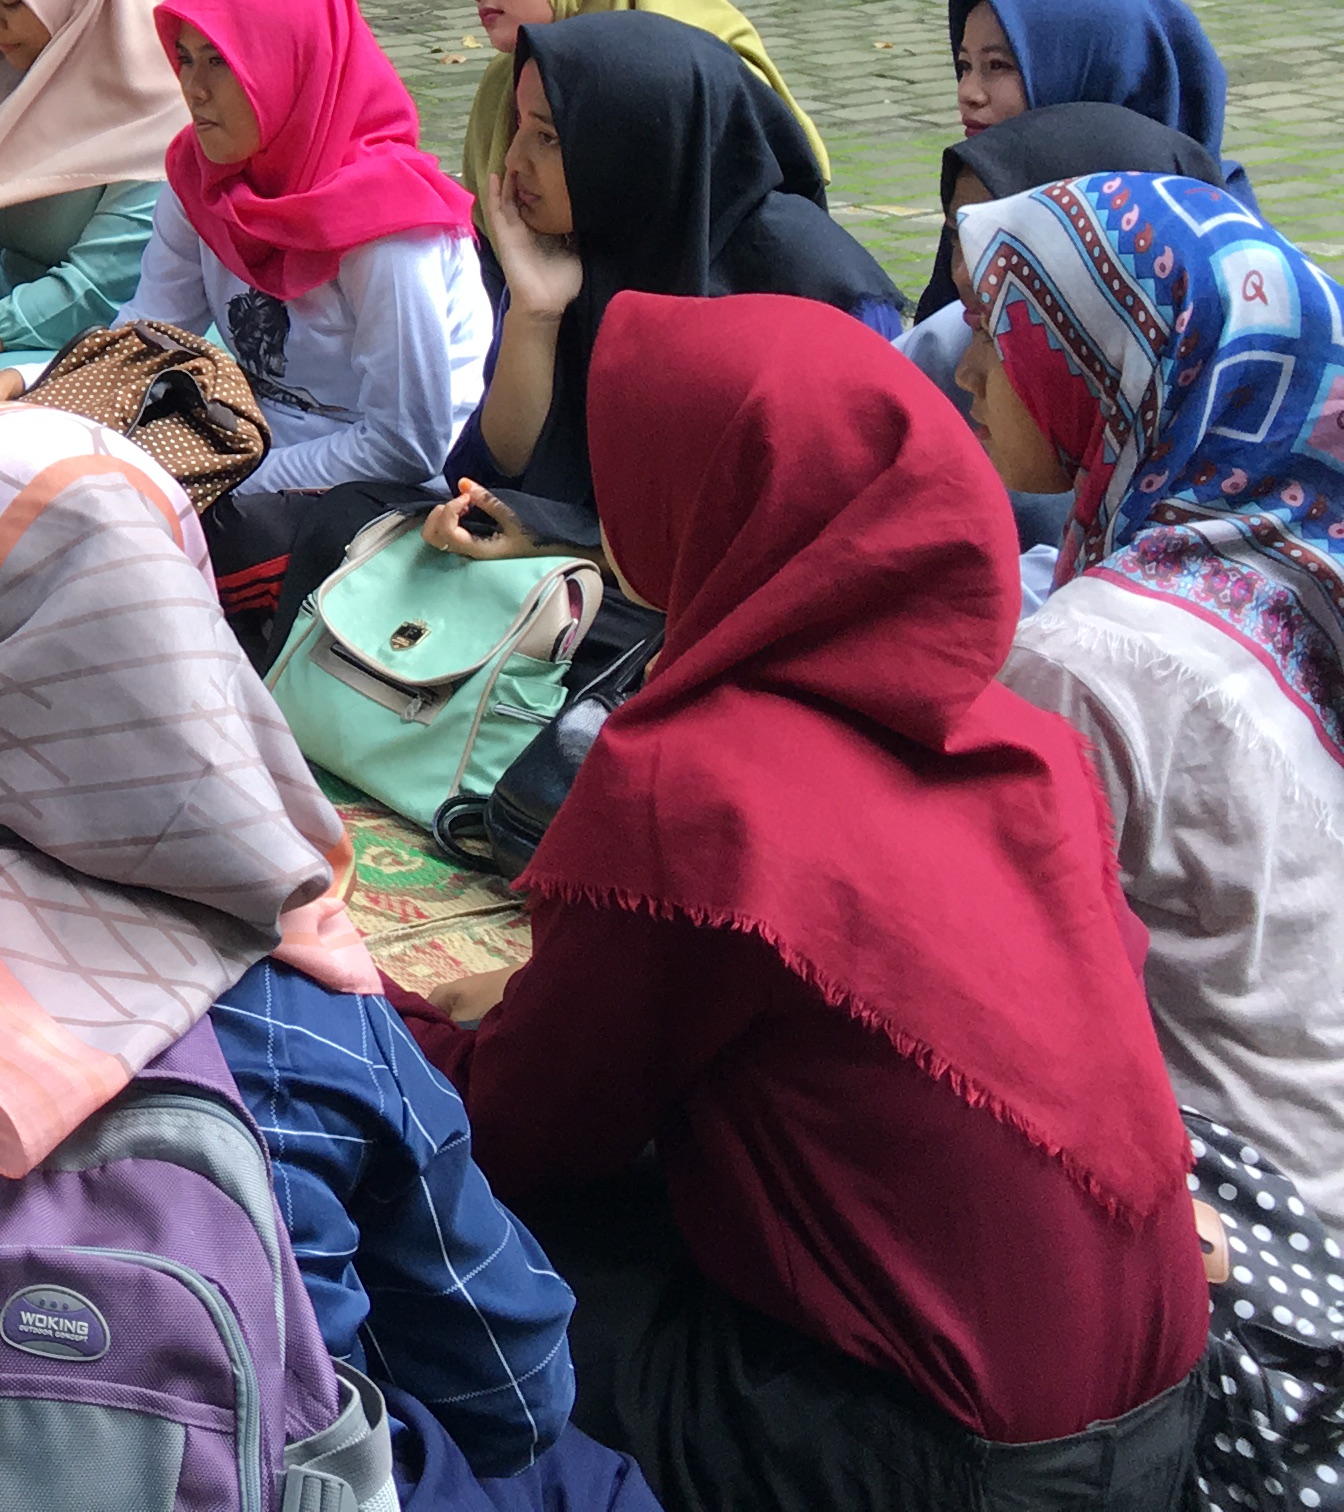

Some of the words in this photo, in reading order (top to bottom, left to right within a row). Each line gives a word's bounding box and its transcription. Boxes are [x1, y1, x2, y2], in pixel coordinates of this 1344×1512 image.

[18, 1324, 54, 1338] OUTDOOR
[54, 1330, 89, 1343] CONCEPT
[20, 1311, 89, 1335] WOKING
